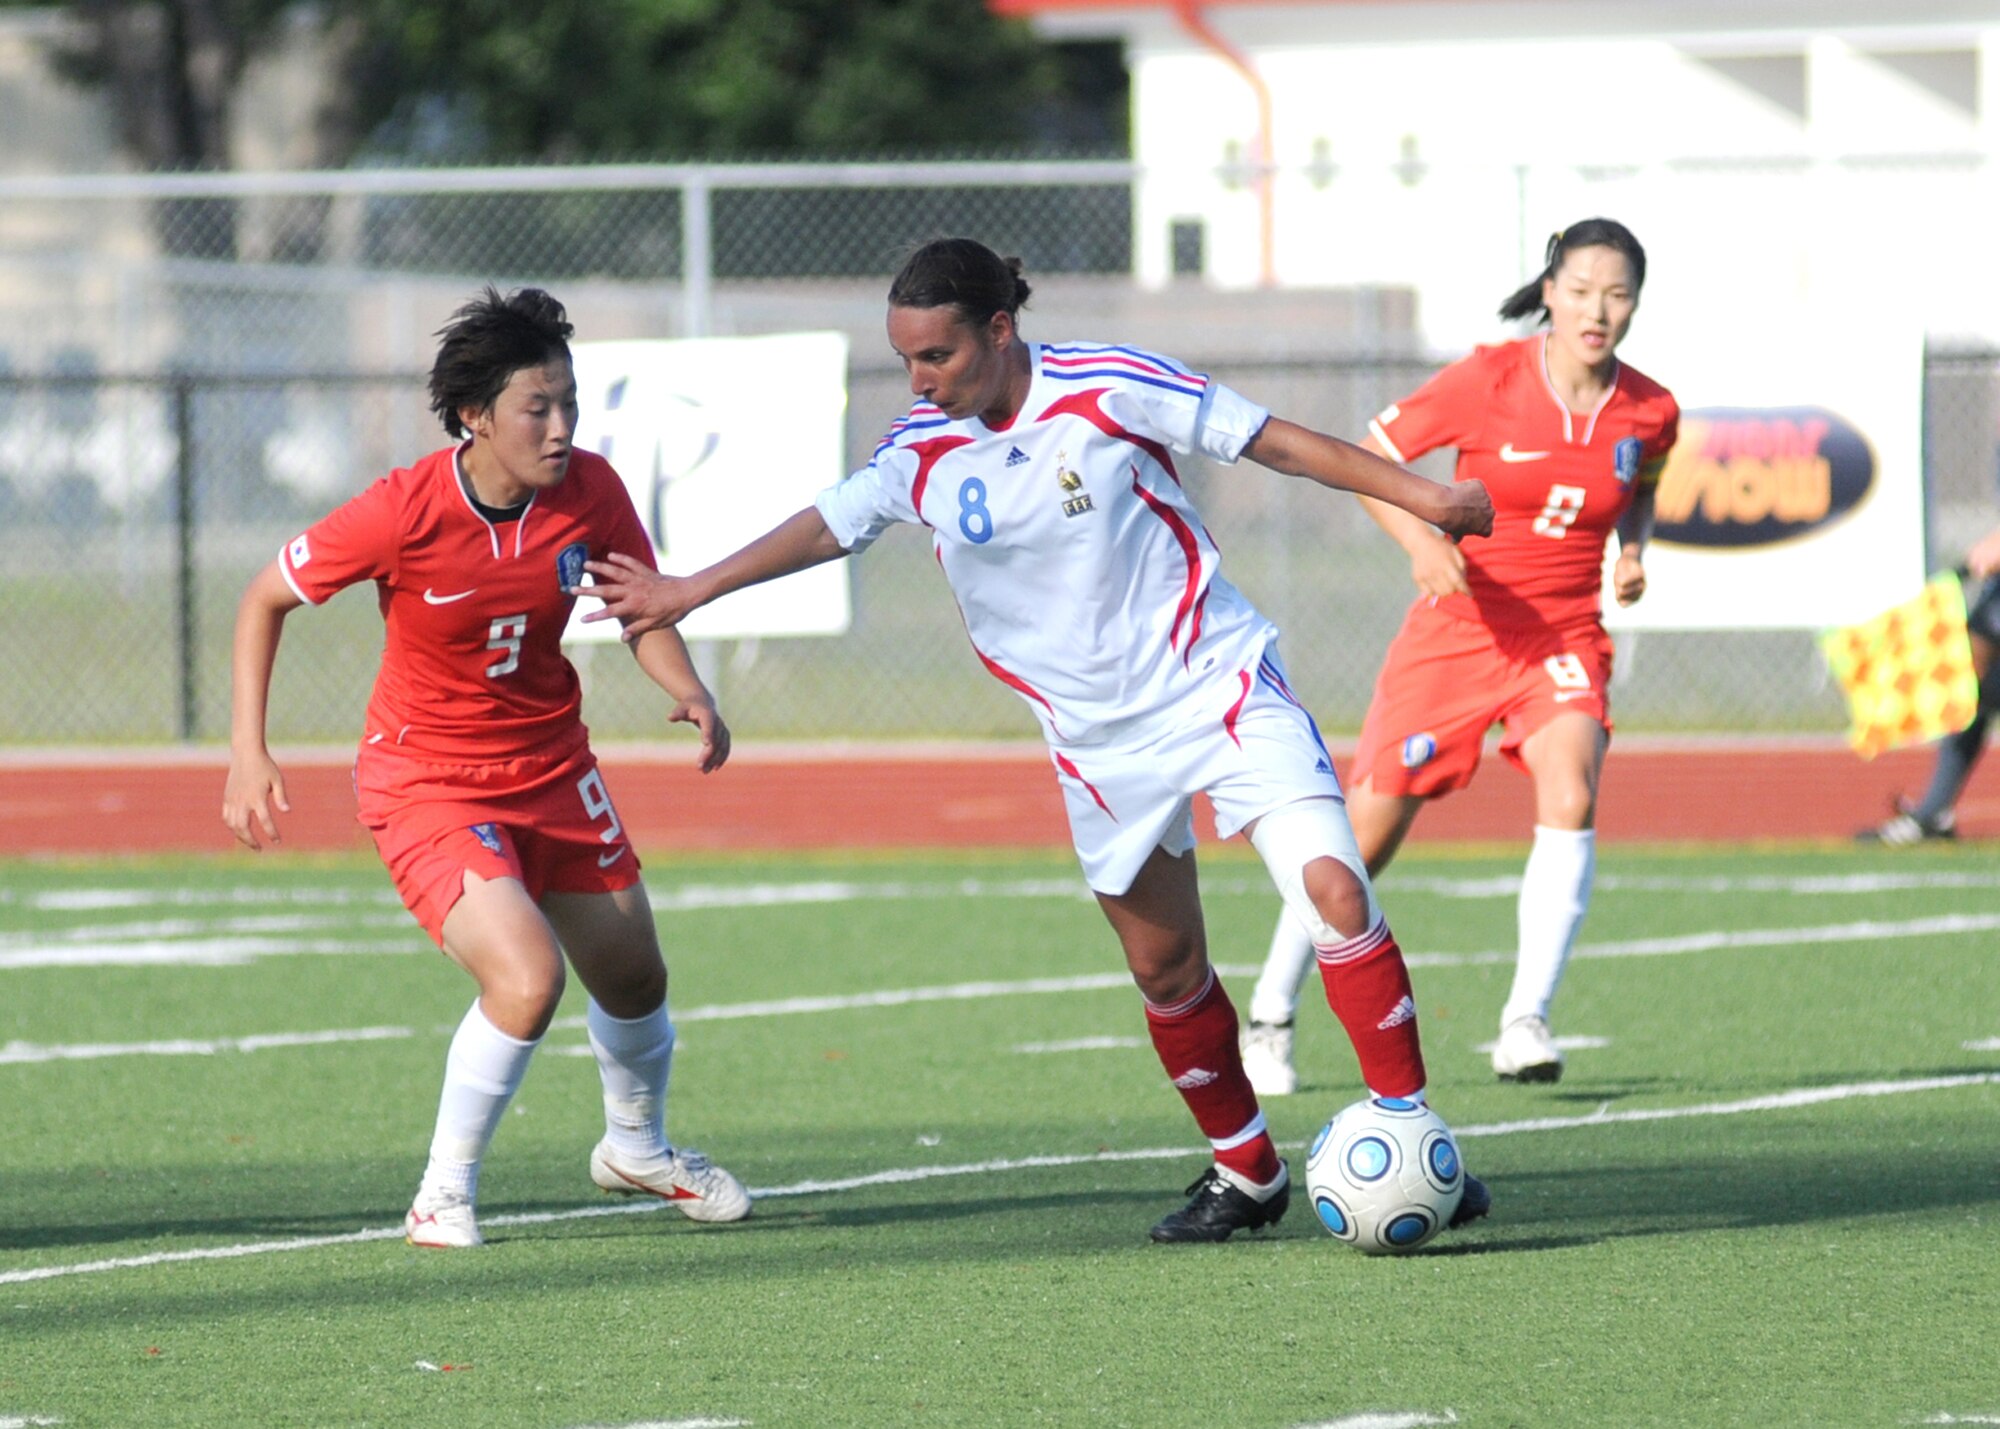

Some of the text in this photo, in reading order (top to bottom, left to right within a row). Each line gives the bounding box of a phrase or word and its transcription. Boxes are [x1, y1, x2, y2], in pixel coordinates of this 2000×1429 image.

[958, 476, 993, 544] 8
[1062, 495, 1092, 516] FFF
[1531, 483, 1586, 539] 8
[486, 614, 527, 678] 9
[1545, 653, 1590, 689] 8
[577, 767, 621, 844] 9
